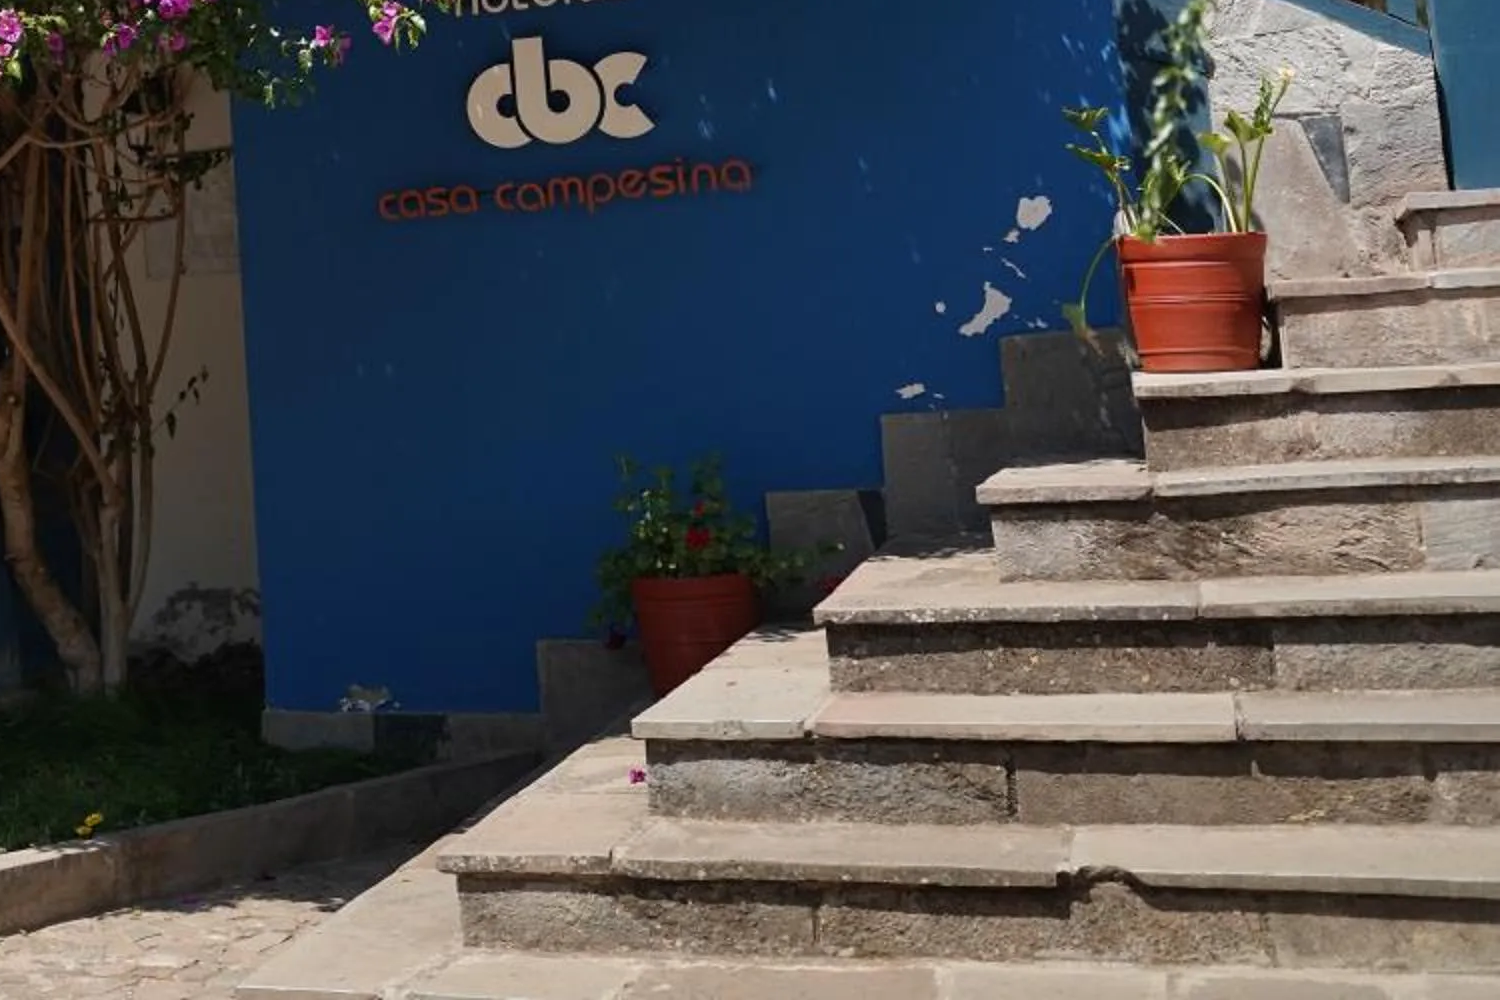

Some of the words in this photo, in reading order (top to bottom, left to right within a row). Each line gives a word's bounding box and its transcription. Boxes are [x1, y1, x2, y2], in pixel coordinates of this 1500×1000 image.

[466, 36, 656, 148] cbc
[378, 181, 480, 221] casa
[492, 157, 753, 214] campesina
